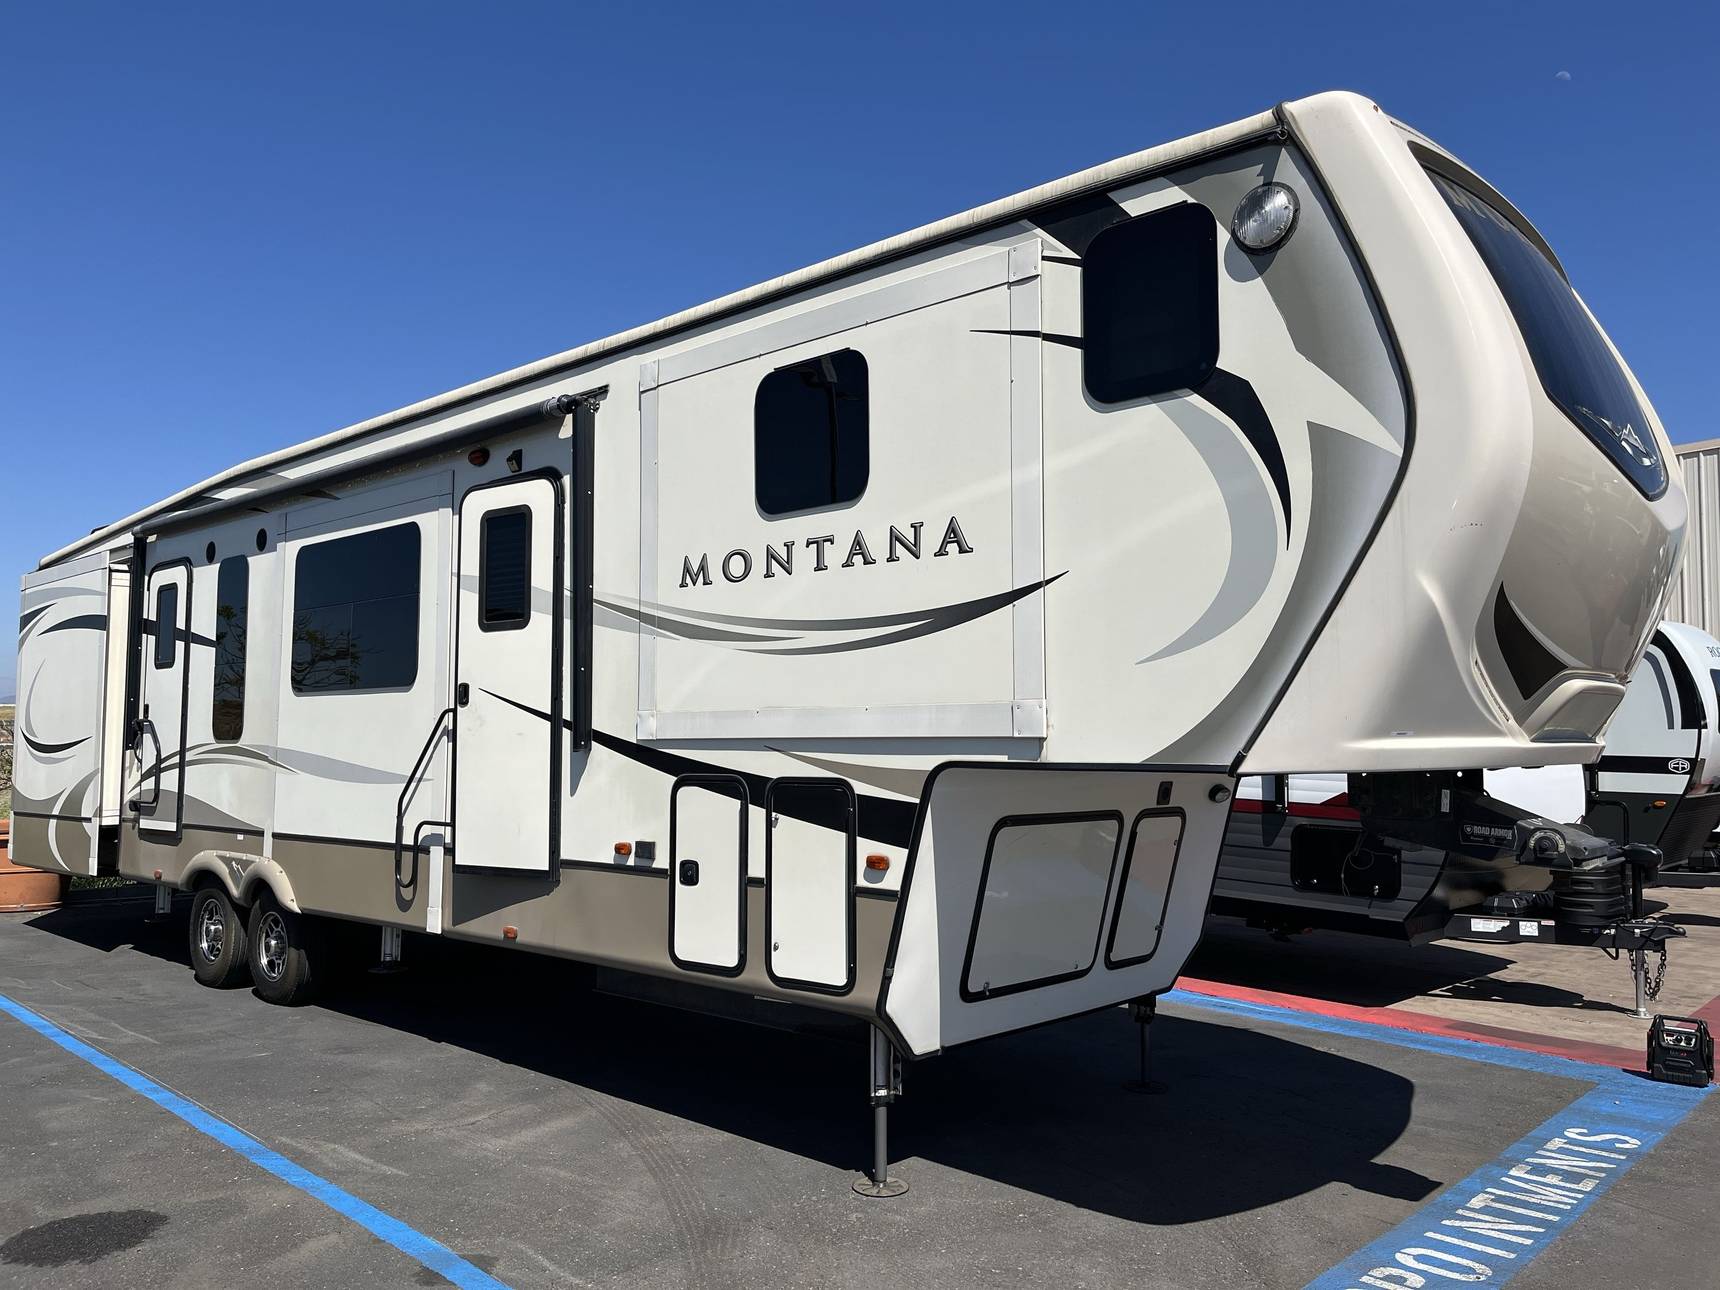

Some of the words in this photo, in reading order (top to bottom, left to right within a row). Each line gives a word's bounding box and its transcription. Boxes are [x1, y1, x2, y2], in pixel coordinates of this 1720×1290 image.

[679, 516, 974, 588] MONTANA
[1473, 825, 1490, 835] ROAD
[1490, 827, 1513, 840] ARMOR
[1345, 1128, 1642, 1290] POINTMENTS
